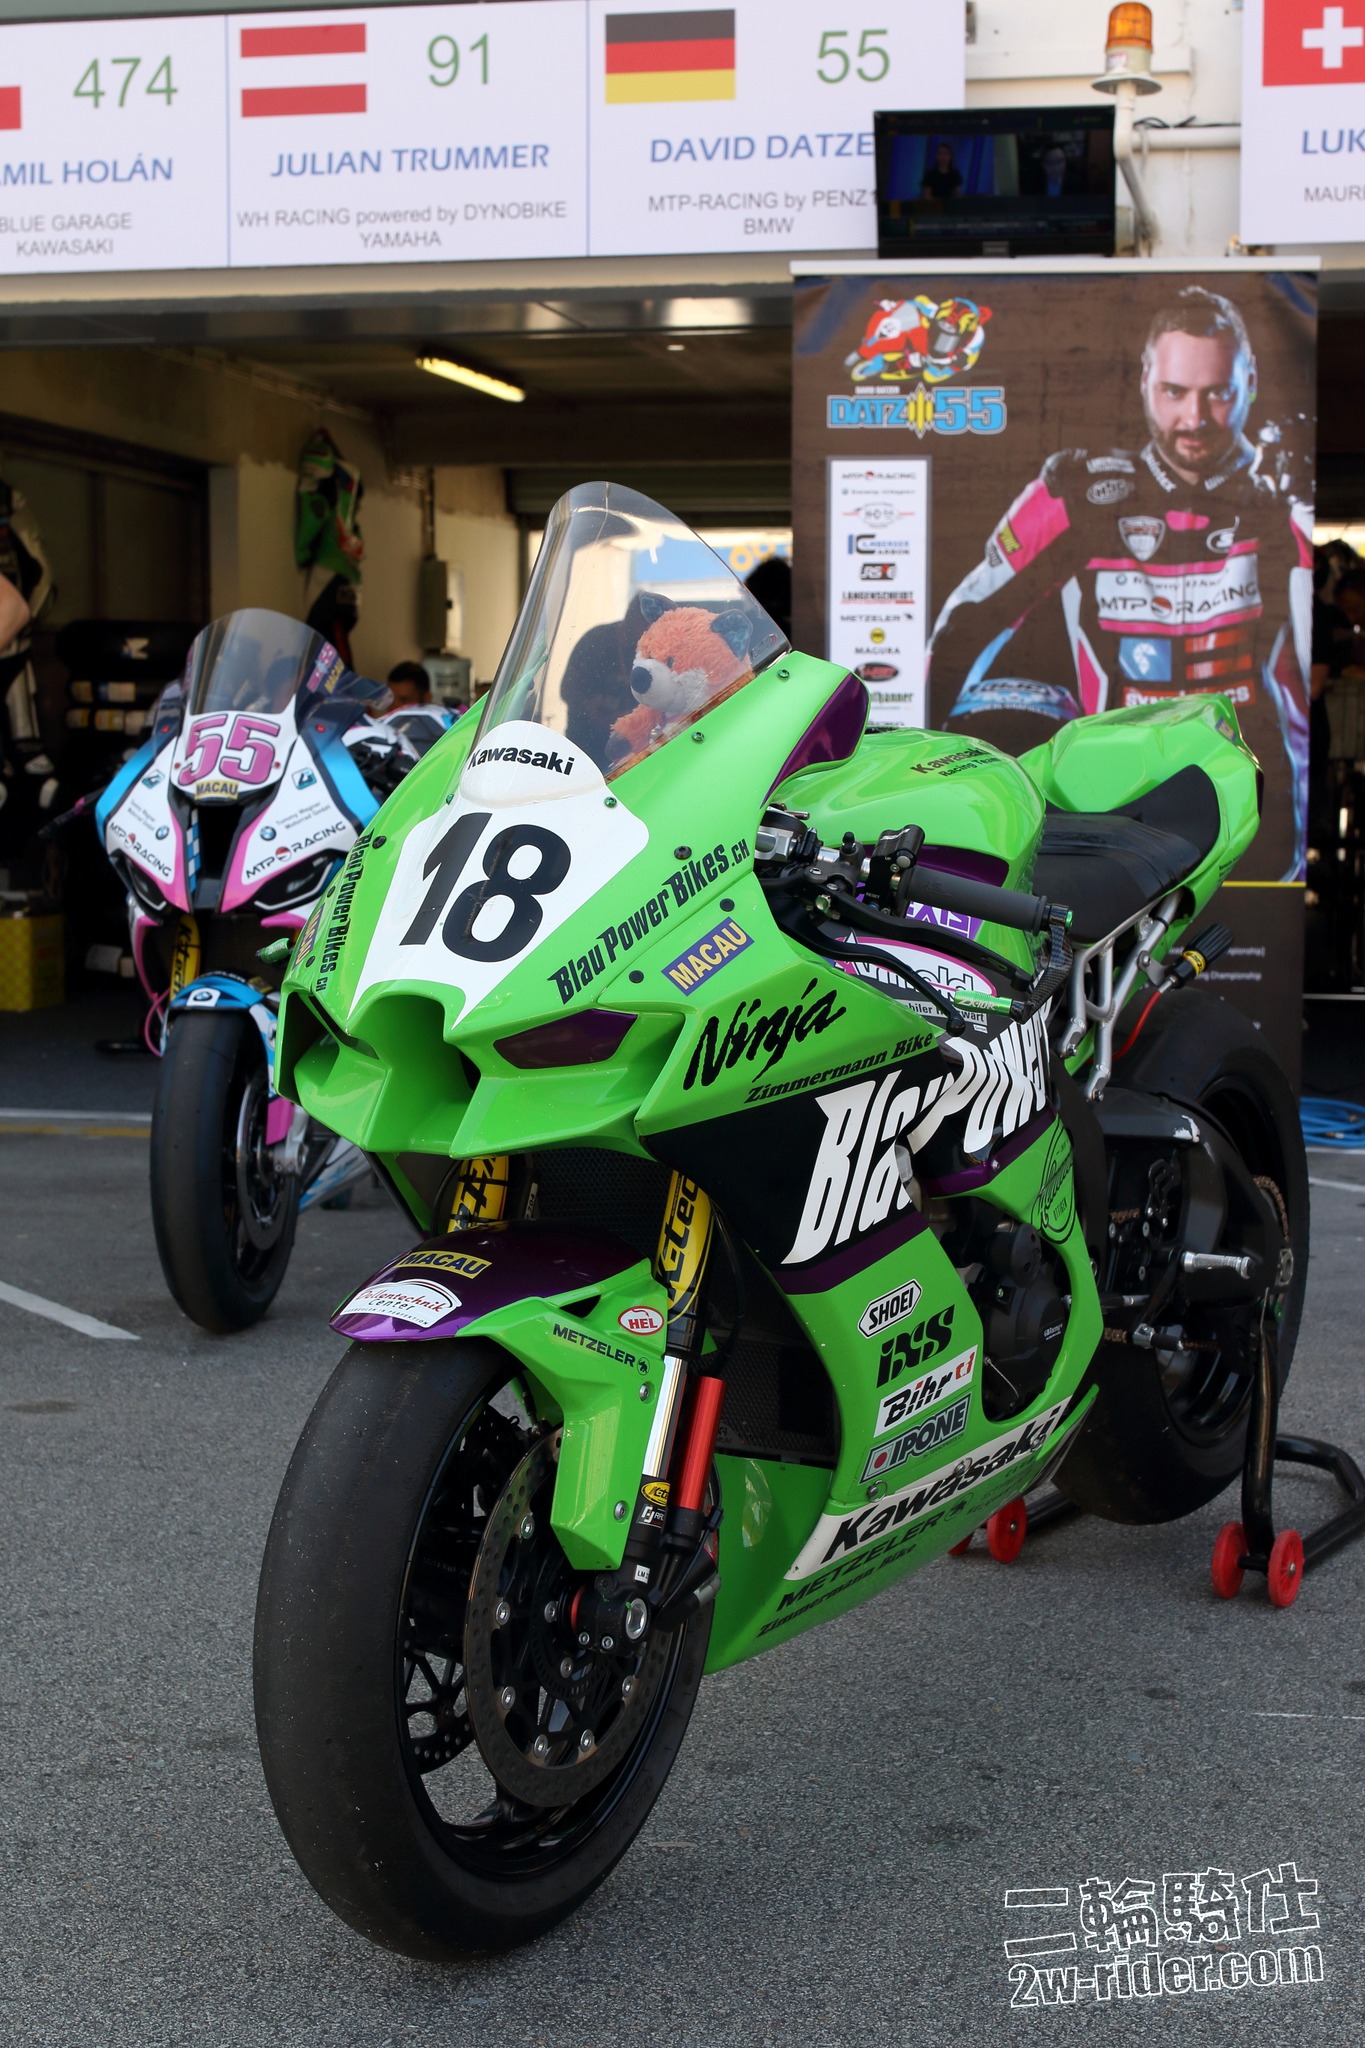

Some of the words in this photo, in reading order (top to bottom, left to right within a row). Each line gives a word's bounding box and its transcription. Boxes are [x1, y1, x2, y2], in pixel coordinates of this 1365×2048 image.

[427, 33, 490, 87] 91
[816, 29, 891, 84] 55
[73, 55, 179, 109] 474
[650, 136, 756, 163] DAVID
[766, 132, 875, 159] DATZE
[1302, 128, 1365, 154] LUK
[0, 162, 53, 186] MIL
[63, 152, 173, 184] HOLÁN
[271, 149, 382, 177] JULIAN
[391, 145, 550, 172] TRUMMER
[237, 210, 270, 229] WH
[275, 208, 351, 227] RACING
[355, 207, 432, 228] powered
[436, 205, 459, 227] by
[463, 201, 567, 222] DYNOBIKE
[648, 192, 779, 212] MTP-RACING
[784, 192, 806, 211] by
[51, 212, 133, 232] GARAGE
[360, 231, 442, 250] YAMAHA
[744, 218, 794, 235] BMW
[16, 238, 114, 257] KAWASAKI
[828, 396, 908, 427] DATZ
[933, 387, 1006, 434] 55
[177, 713, 281, 786] 55
[467, 747, 575, 776] Kawasaki
[938, 761, 974, 777] Racing
[196, 782, 239, 796] MACAU
[133, 842, 172, 877] RACING
[245, 856, 275, 879] MTP
[291, 821, 346, 853] RACING
[399, 812, 572, 963] 18
[668, 921, 748, 990] MACAU
[683, 977, 847, 1090] Ninja
[744, 1049, 888, 1104] Zimmermann
[890, 1031, 933, 1060] Bike
[400, 1252, 484, 1275] MACAU
[368, 1298, 416, 1311] Center
[628, 1316, 659, 1331] HEL
[869, 1287, 914, 1331] SHOEI
[553, 1323, 636, 1368] METZELER
[883, 1371, 953, 1428] Bihr
[889, 1400, 967, 1467] IPONE
[821, 1404, 1062, 1564] Kawasaki
[777, 1513, 945, 1612] METZELER
[756, 1566, 874, 1638] Zimmermann
